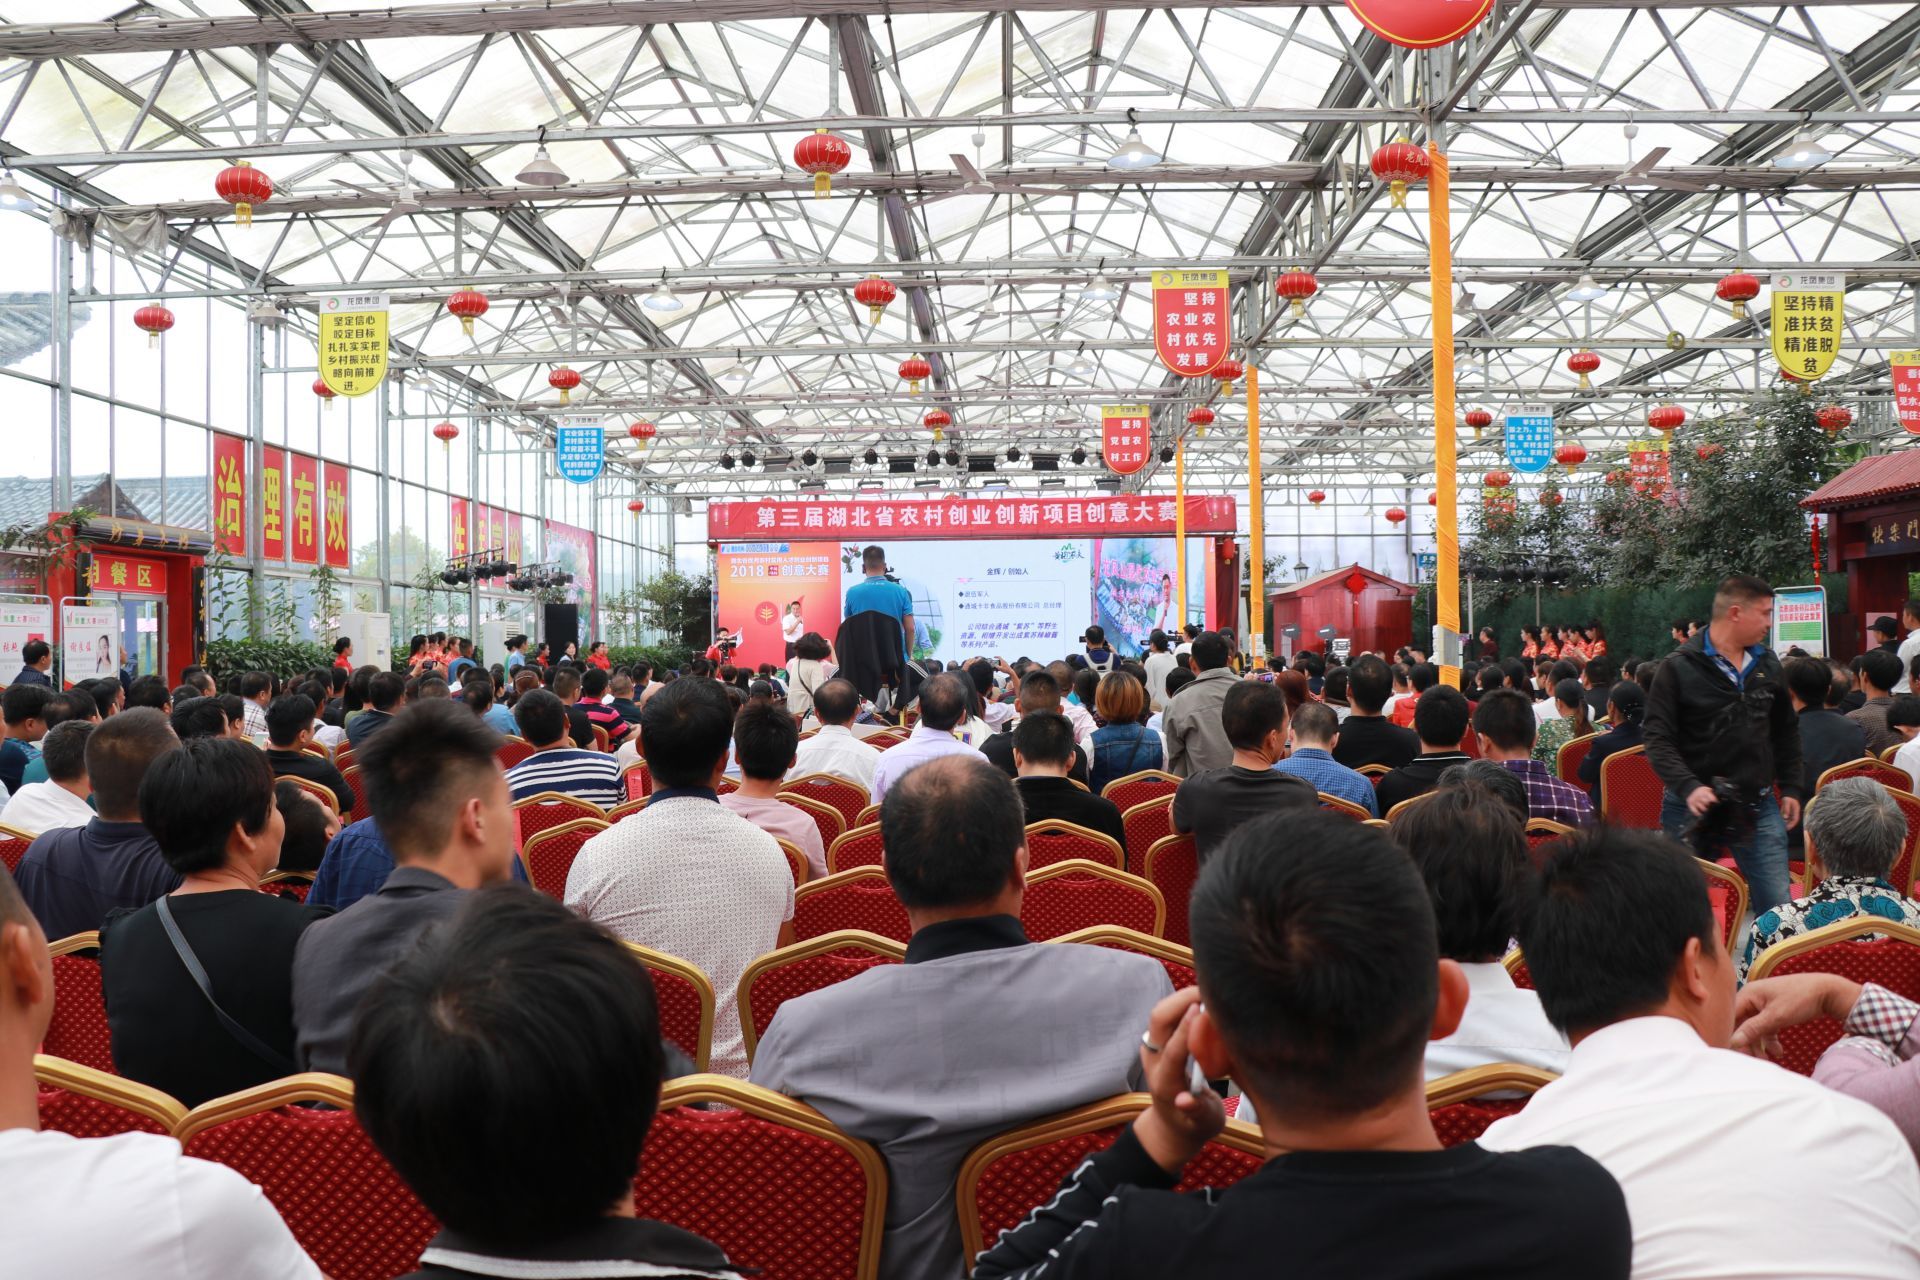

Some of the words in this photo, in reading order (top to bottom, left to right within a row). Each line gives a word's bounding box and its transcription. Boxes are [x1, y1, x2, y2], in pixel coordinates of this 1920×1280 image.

[1184, 292, 1216, 306] 坚持
[1784, 296, 1834, 311] 坚持精
[334, 315, 376, 326] 坚定信心
[1166, 313, 1216, 326] 农业农
[1784, 316, 1834, 332] 准扶贫
[334, 328, 376, 339] 咬定目标
[1167, 333, 1217, 347] 村优先
[1784, 337, 1833, 352] 精准脱
[328, 341, 380, 353] 扎扎实实把
[328, 354, 380, 366] 乡村振兴战
[1177, 353, 1208, 367] 发展
[1804, 357, 1818, 373] 贫
[333, 368, 375, 378] 略向前推
[1122, 420, 1141, 429] 坚持
[1110, 436, 1142, 446] 党管农
[1110, 452, 1142, 462] 村工作
[217, 455, 347, 552] 治理有效
[756, 500, 1178, 528] 第三届湖北省农村创业创新项目创意大赛
[731, 565, 764, 577] 2018
[782, 565, 829, 576] 创意大赛
[1008, 568, 1029, 576] 创始人
